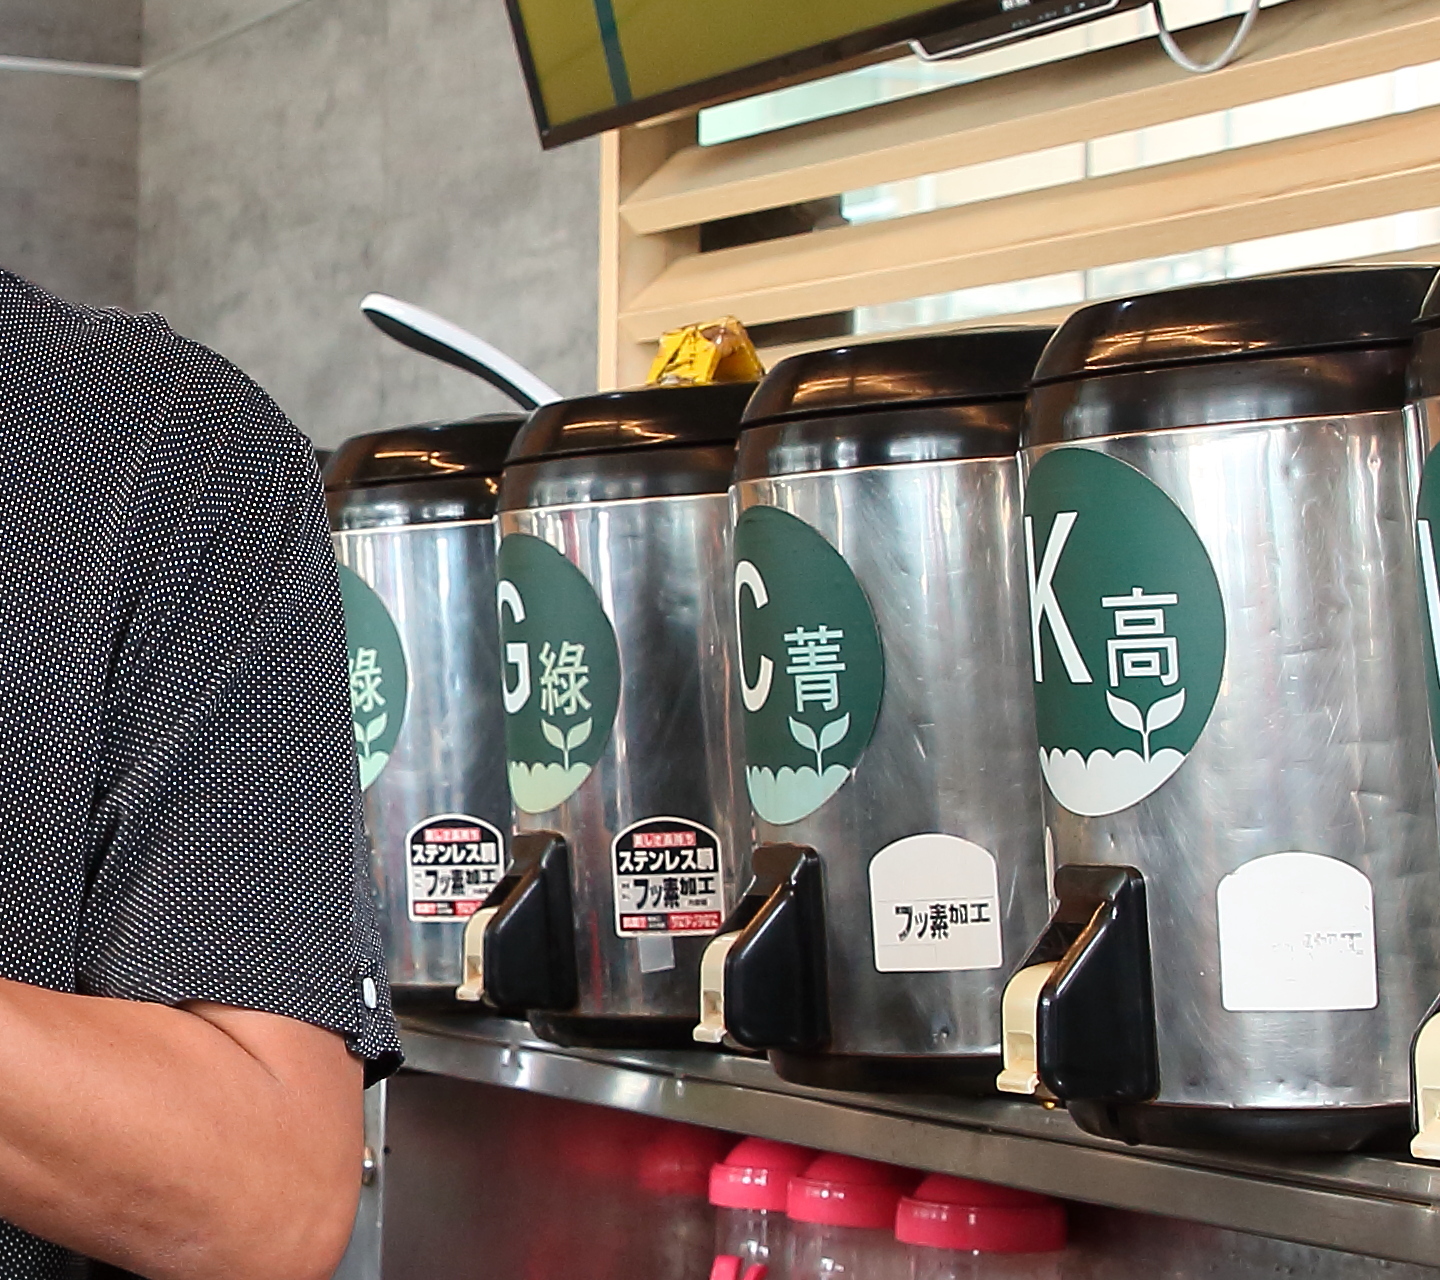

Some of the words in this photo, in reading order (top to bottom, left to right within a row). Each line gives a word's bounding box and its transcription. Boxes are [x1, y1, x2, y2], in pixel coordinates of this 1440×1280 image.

[497, 580, 531, 713] G
[539, 639, 592, 719] 綠
[735, 560, 773, 714] C
[784, 625, 847, 713] 菁
[1025, 510, 1093, 685] K
[1102, 587, 1180, 688] 高
[895, 902, 991, 942] フッ素加工
